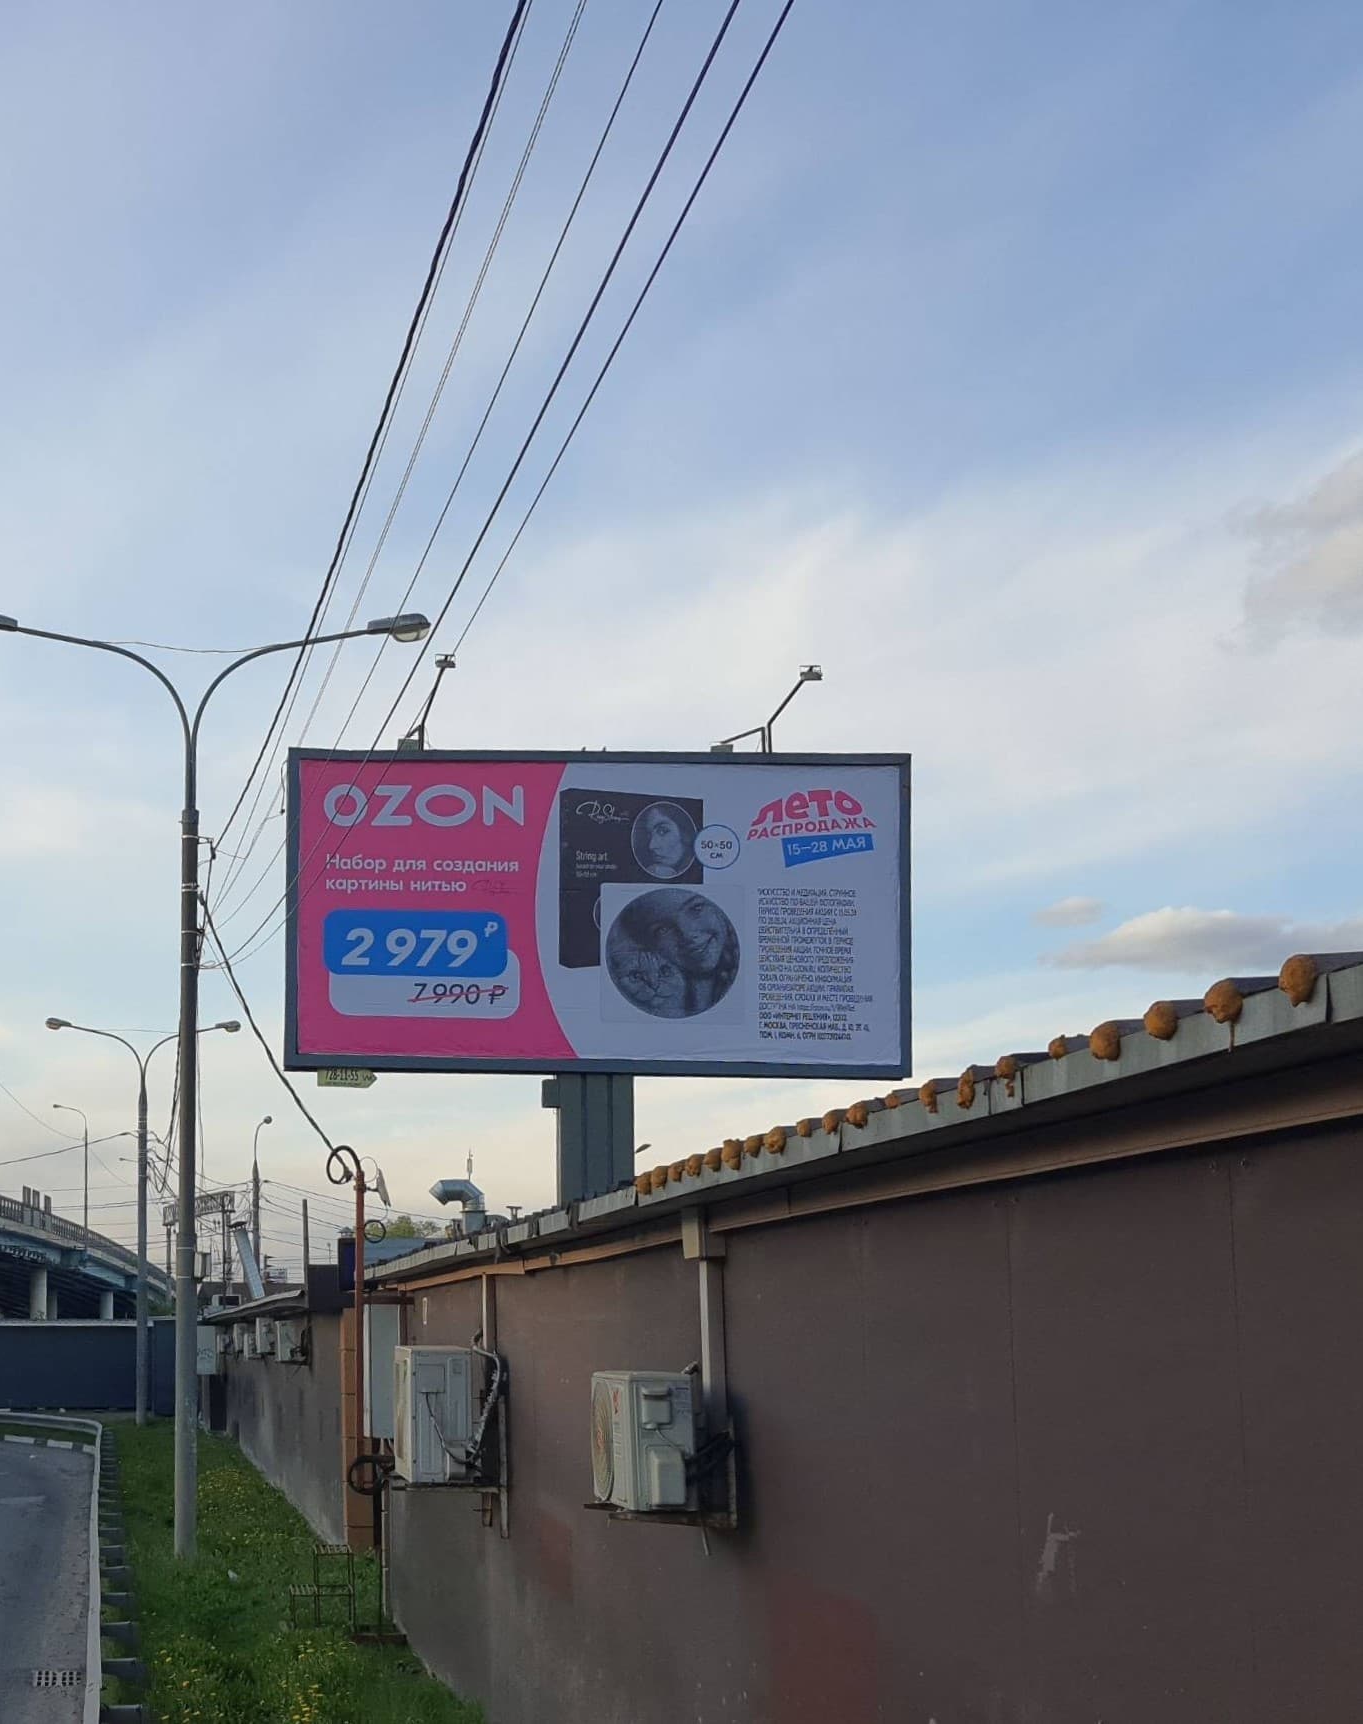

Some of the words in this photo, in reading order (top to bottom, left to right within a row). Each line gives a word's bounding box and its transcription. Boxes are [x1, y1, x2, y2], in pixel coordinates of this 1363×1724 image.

[323, 784, 525, 828] OZON
[747, 817, 877, 840] РАСПРОДАЖА
[832, 836, 866, 851] МАЯ
[326, 854, 387, 873] Набор
[392, 858, 427, 873] для
[433, 858, 519, 873] создания
[325, 878, 404, 894] картины
[410, 879, 467, 892] нитью
